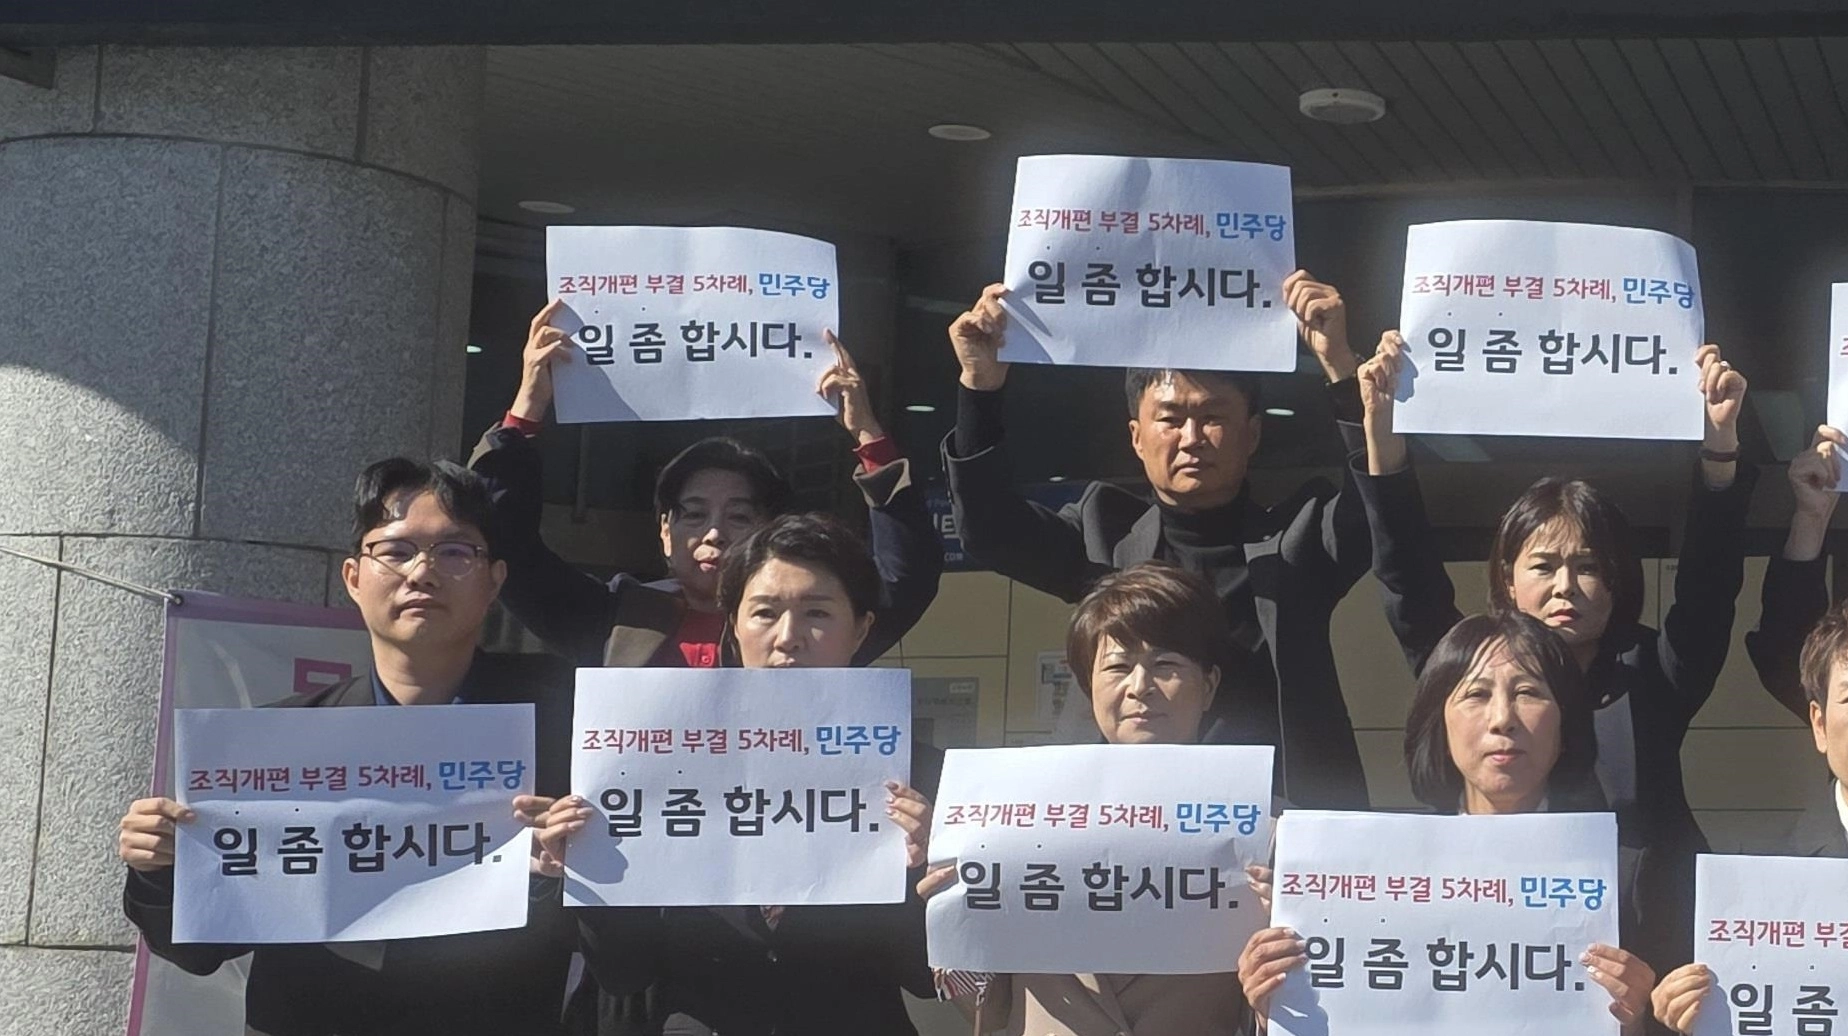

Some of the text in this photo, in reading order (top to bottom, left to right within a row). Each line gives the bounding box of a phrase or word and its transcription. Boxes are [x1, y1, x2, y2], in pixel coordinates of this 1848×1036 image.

[1018, 209, 1286, 241] 조직개편 부결 5차례, 민주당
[558, 273, 830, 299] 조직개편 부결 5차례, 민주당
[1029, 262, 1271, 307] 일 좀 합시다.
[1413, 274, 1695, 309] 조직개편 부결 5차례, 민주당
[579, 321, 811, 365] 일 좀 합시다.
[1429, 328, 1676, 374] 일 좀 합시다.
[582, 726, 901, 755] 조직개편 부결 5차례, 민주당
[189, 761, 526, 793] 조직개편 부결 5차례, 민주당
[601, 786, 878, 837] 일 좀 합시다.
[944, 803, 1261, 835] 조직개편 부결 5차례, 민주당
[214, 822, 502, 875] 일 좀 합시다.
[961, 862, 1238, 911] 일 좀 합시다.
[1281, 874, 1607, 910] 조직개편 부결 5차례, 민주당
[1708, 920, 1805, 948] 조직개편
[1305, 937, 1583, 991] 일 좀 합시다.
[1731, 984, 1772, 1035] 일
[1793, 986, 1837, 1036] 좀
